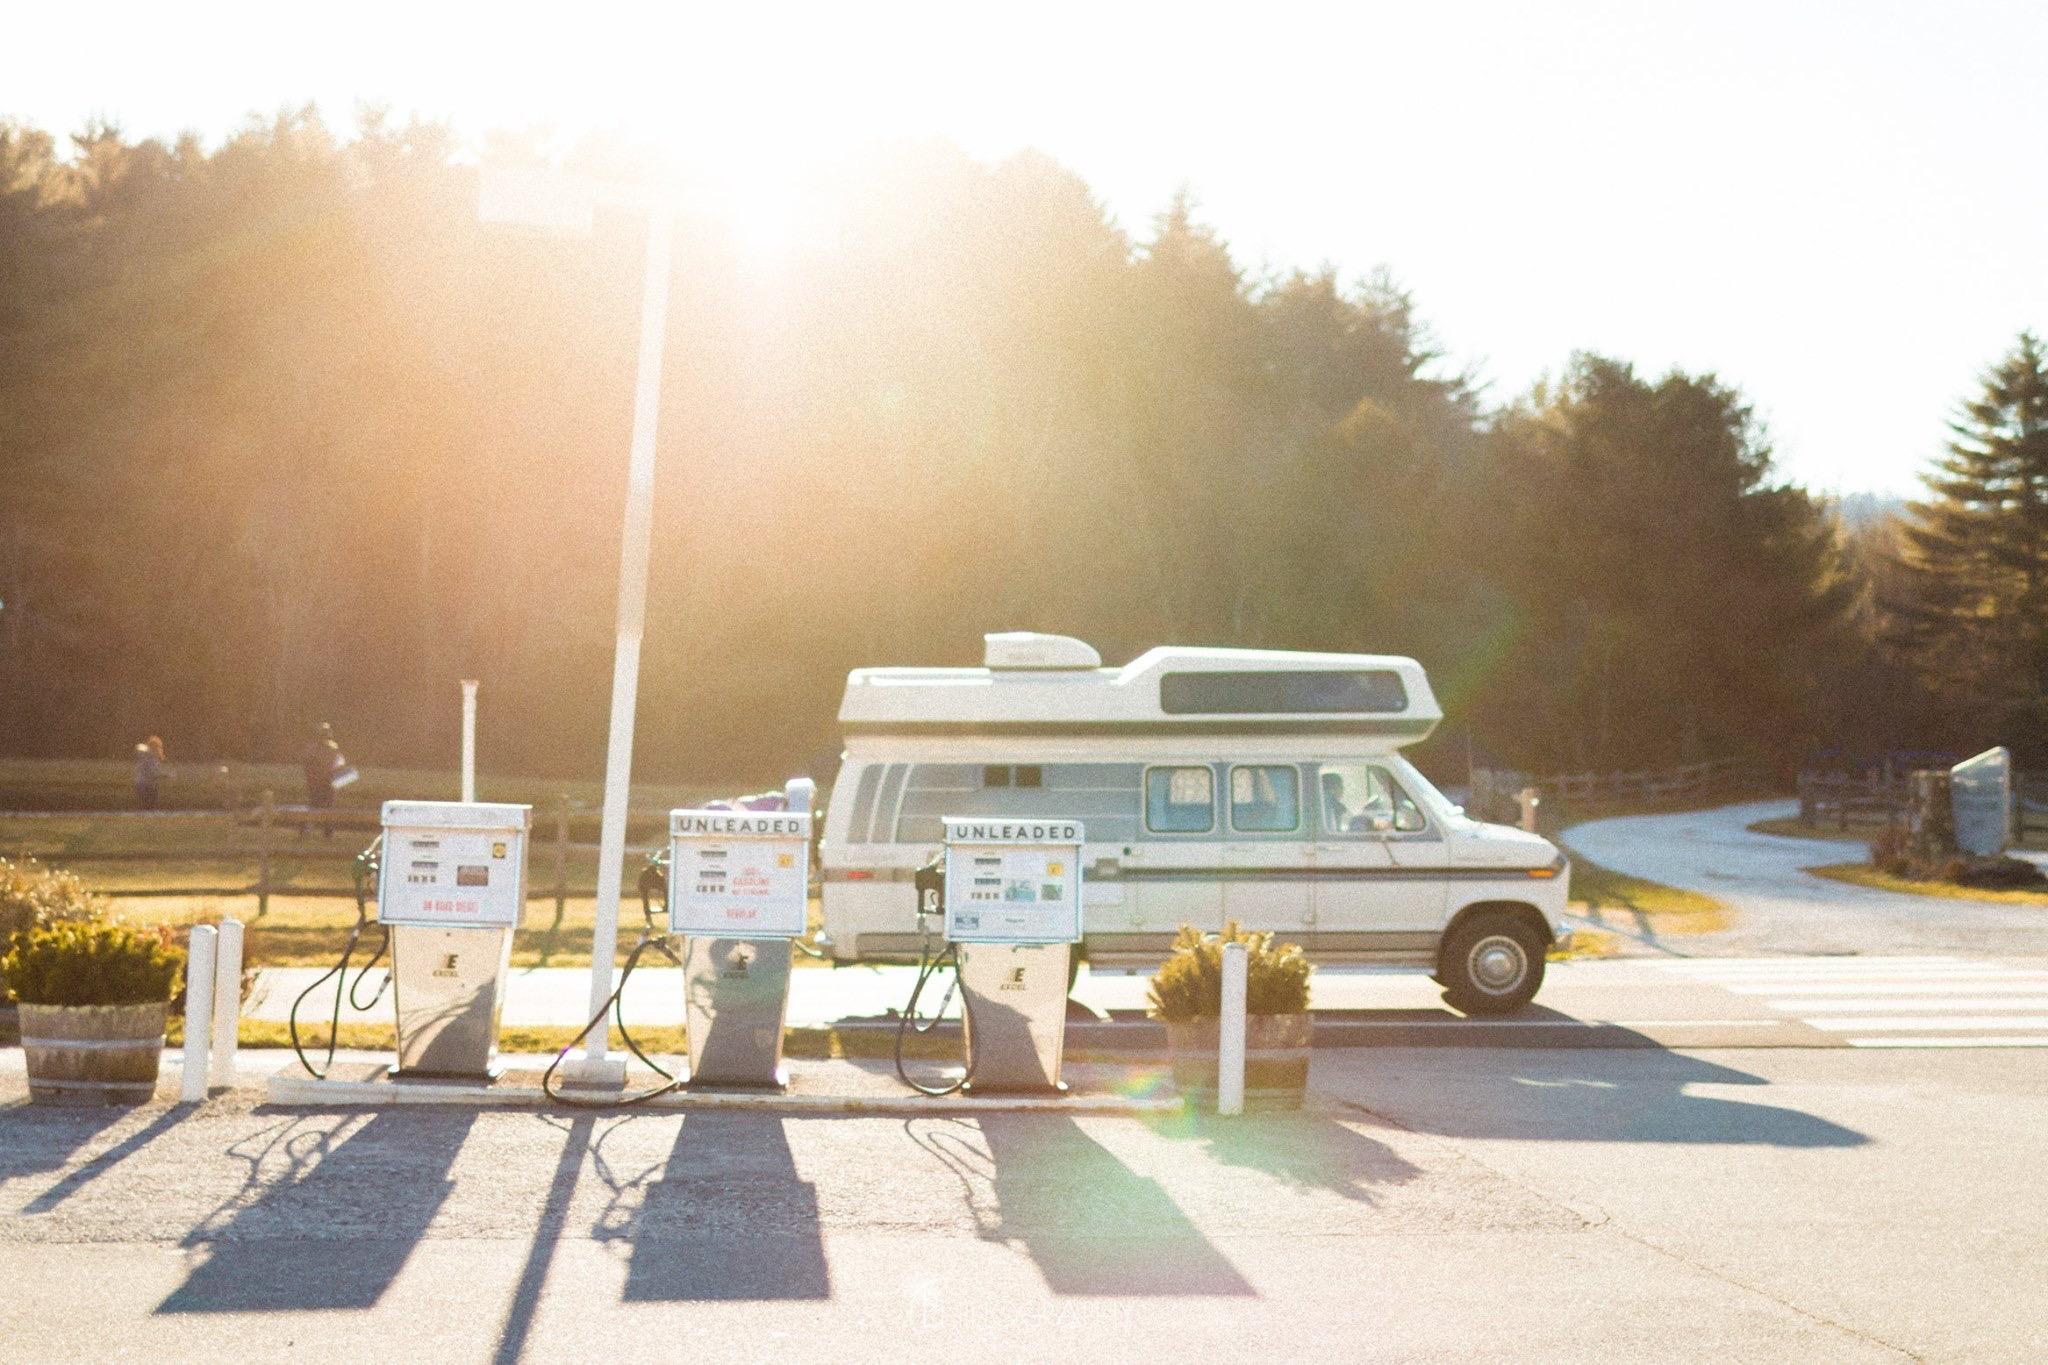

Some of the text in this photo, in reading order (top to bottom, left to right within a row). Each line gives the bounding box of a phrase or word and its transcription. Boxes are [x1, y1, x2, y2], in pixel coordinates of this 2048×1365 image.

[680, 819, 800, 833] UNLEADED
[956, 825, 1076, 839] UNLEADED
[1014, 967, 1026, 982] E
